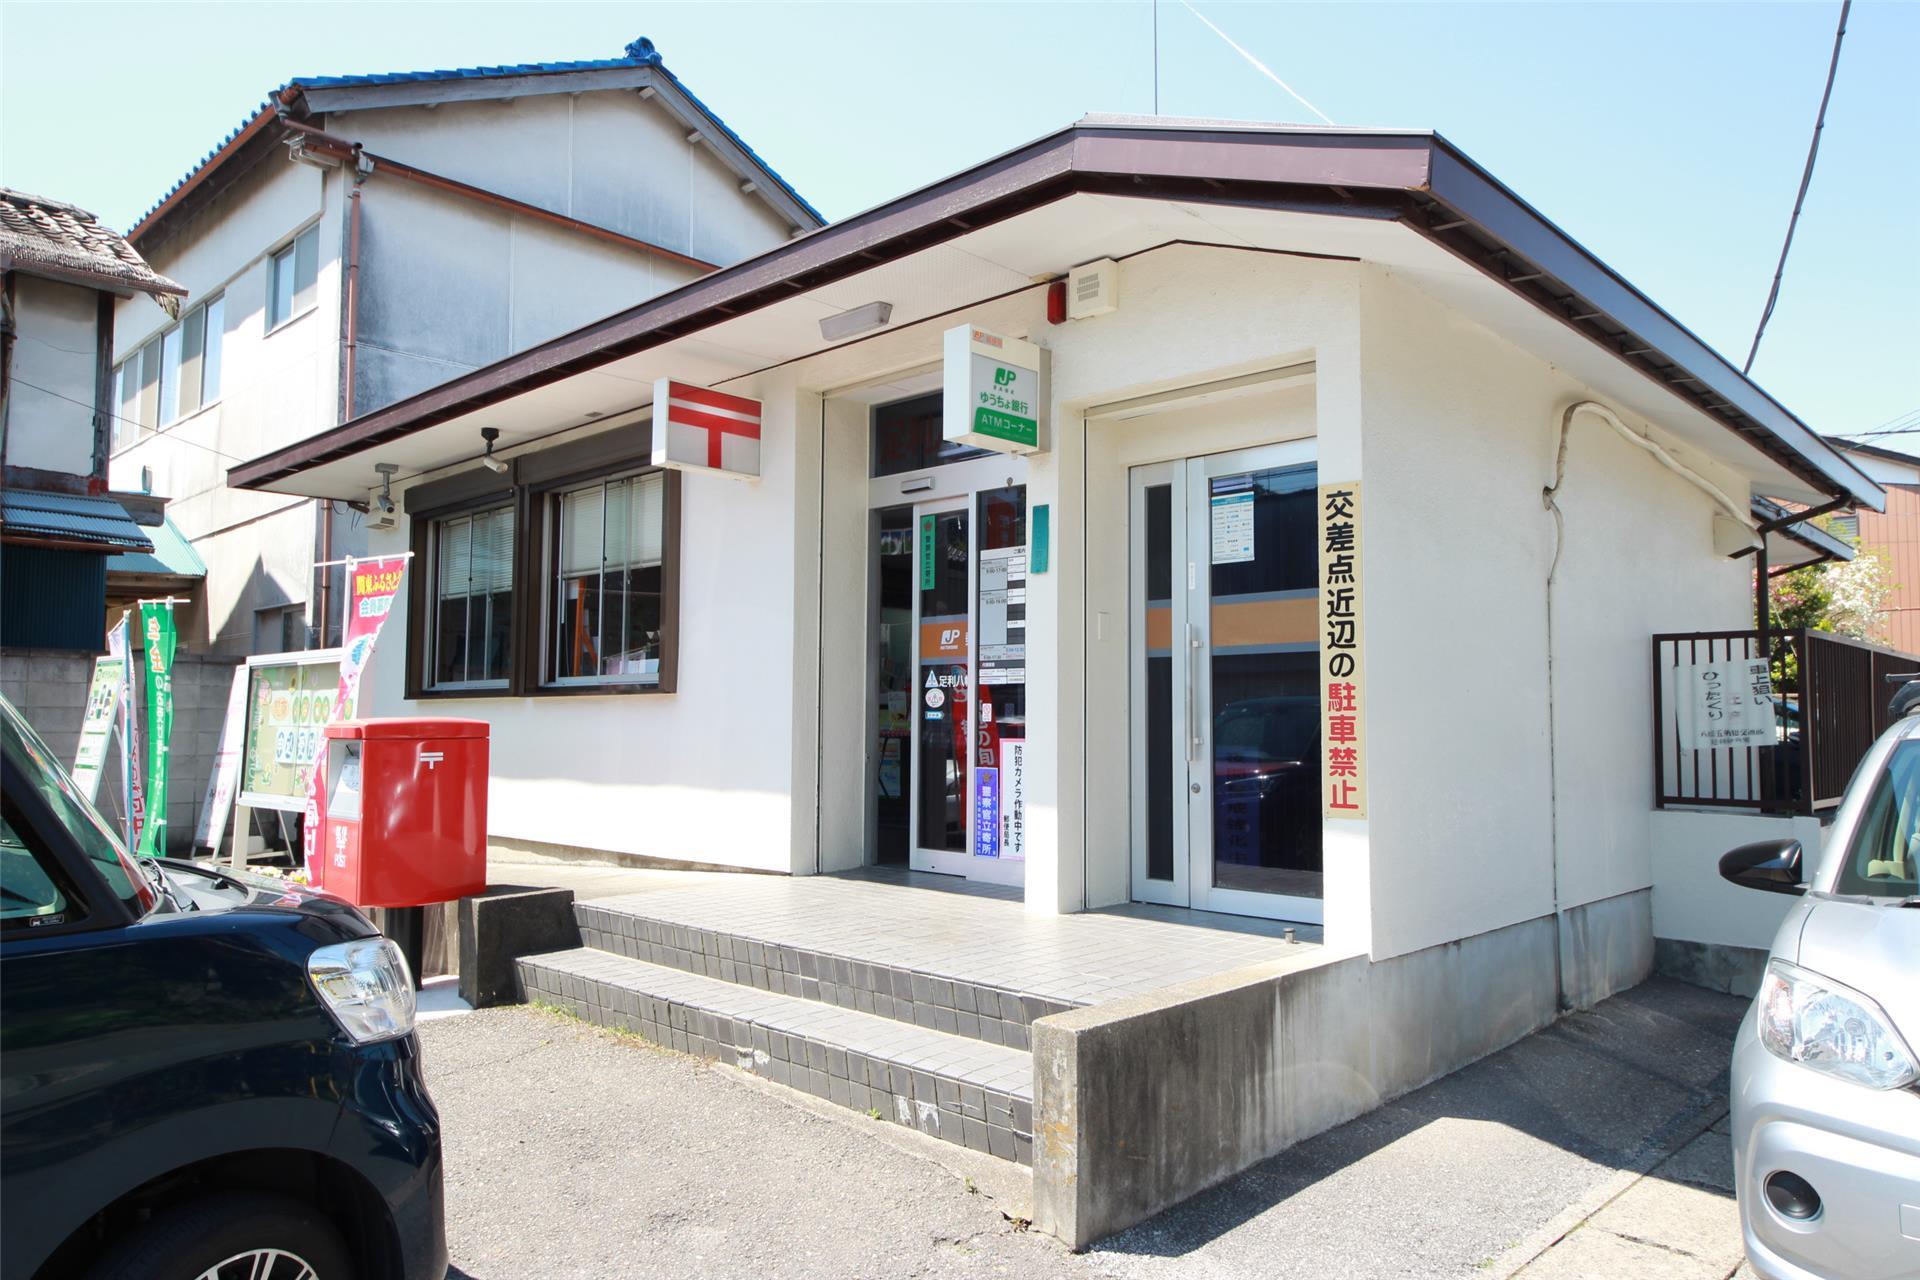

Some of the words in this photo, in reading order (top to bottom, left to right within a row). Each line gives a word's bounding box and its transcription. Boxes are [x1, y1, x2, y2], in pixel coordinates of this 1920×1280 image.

[994, 367, 1016, 386] JP
[980, 391, 1029, 415] ゆうちょ銀行
[981, 414, 1033, 433] ATMコーナー
[941, 629, 960, 645] JP
[1325, 490, 1359, 810] 交差点近辺の駐車禁止
[1014, 745, 1023, 853] 防犯カメラ作動中です
[981, 786, 992, 855] 警察官立寄所
